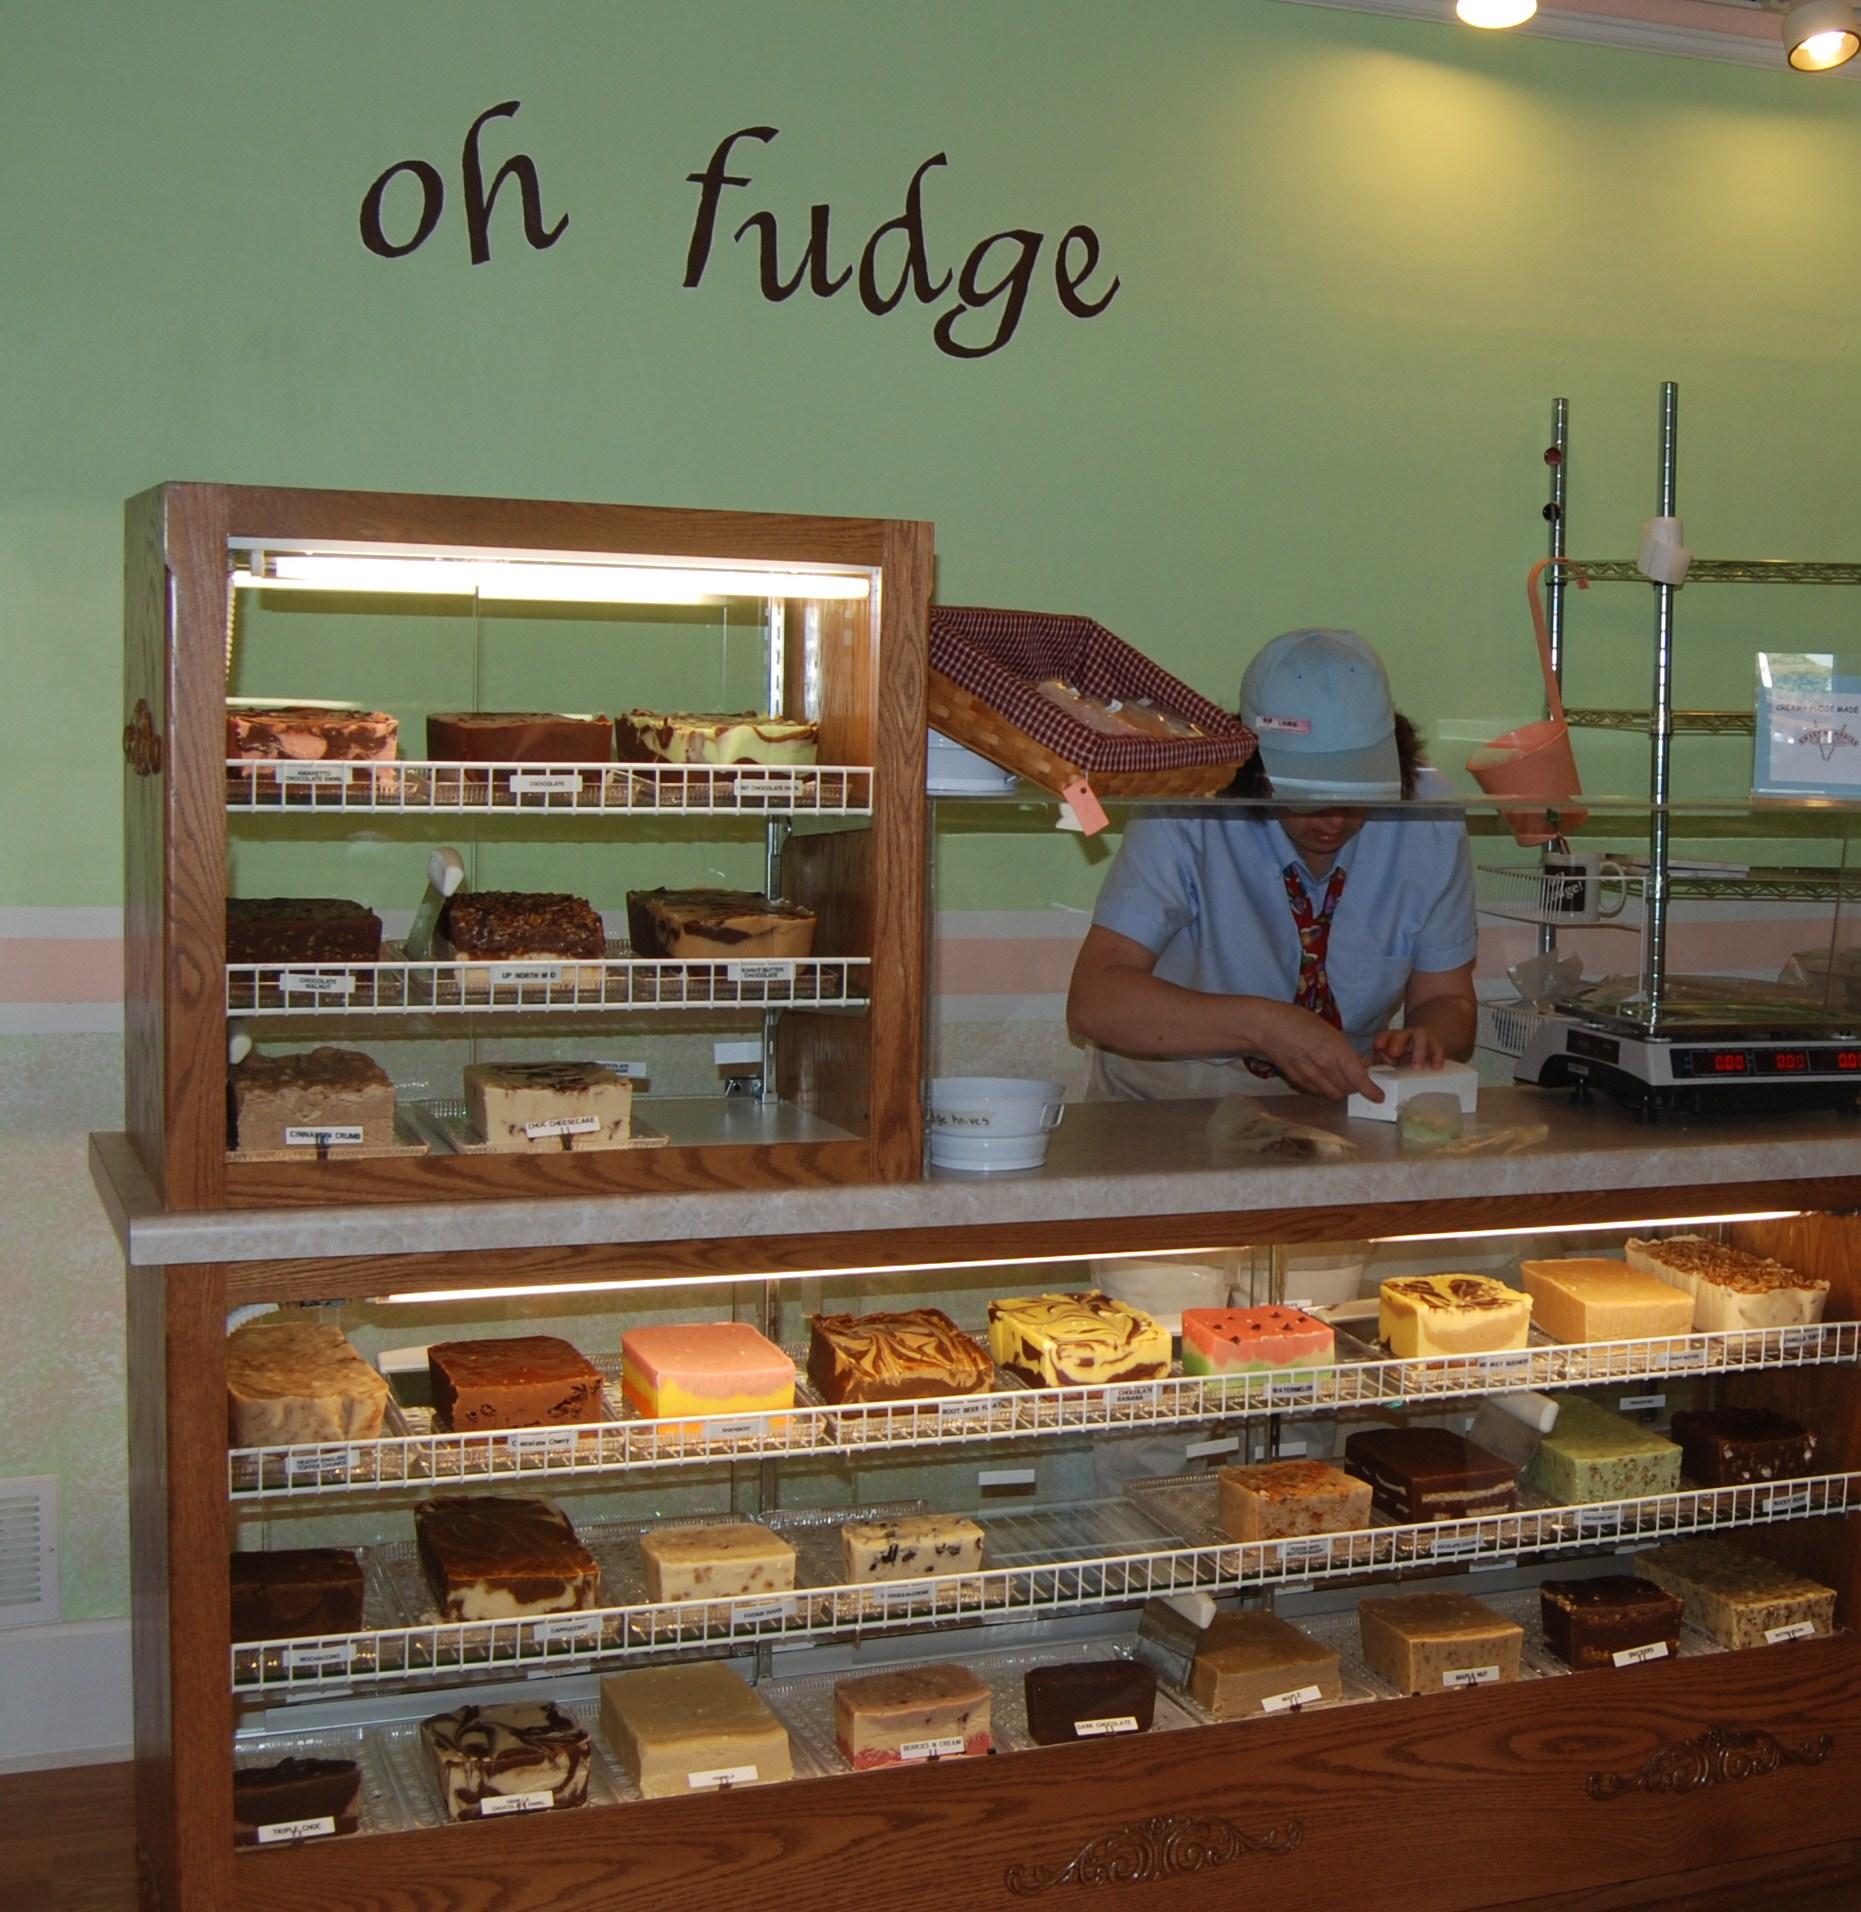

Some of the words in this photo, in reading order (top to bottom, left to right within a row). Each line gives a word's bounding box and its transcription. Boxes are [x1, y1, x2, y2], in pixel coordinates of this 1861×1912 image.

[360, 100, 569, 266] oh
[682, 125, 1121, 359] fudge
[527, 1121, 546, 1129] CHOC
[548, 1117, 594, 1128] CHEESECAKE
[335, 1132, 361, 1140] CRUMB
[1118, 1387, 1153, 1396] CHOCOLATE
[1272, 1385, 1313, 1393] WATERMELON
[1095, 1719, 1131, 1728] CHOCOLATE
[903, 1742, 930, 1752] BERRIES
[939, 1739, 962, 1748] CREAM
[302, 1822, 321, 1831] CHOC
